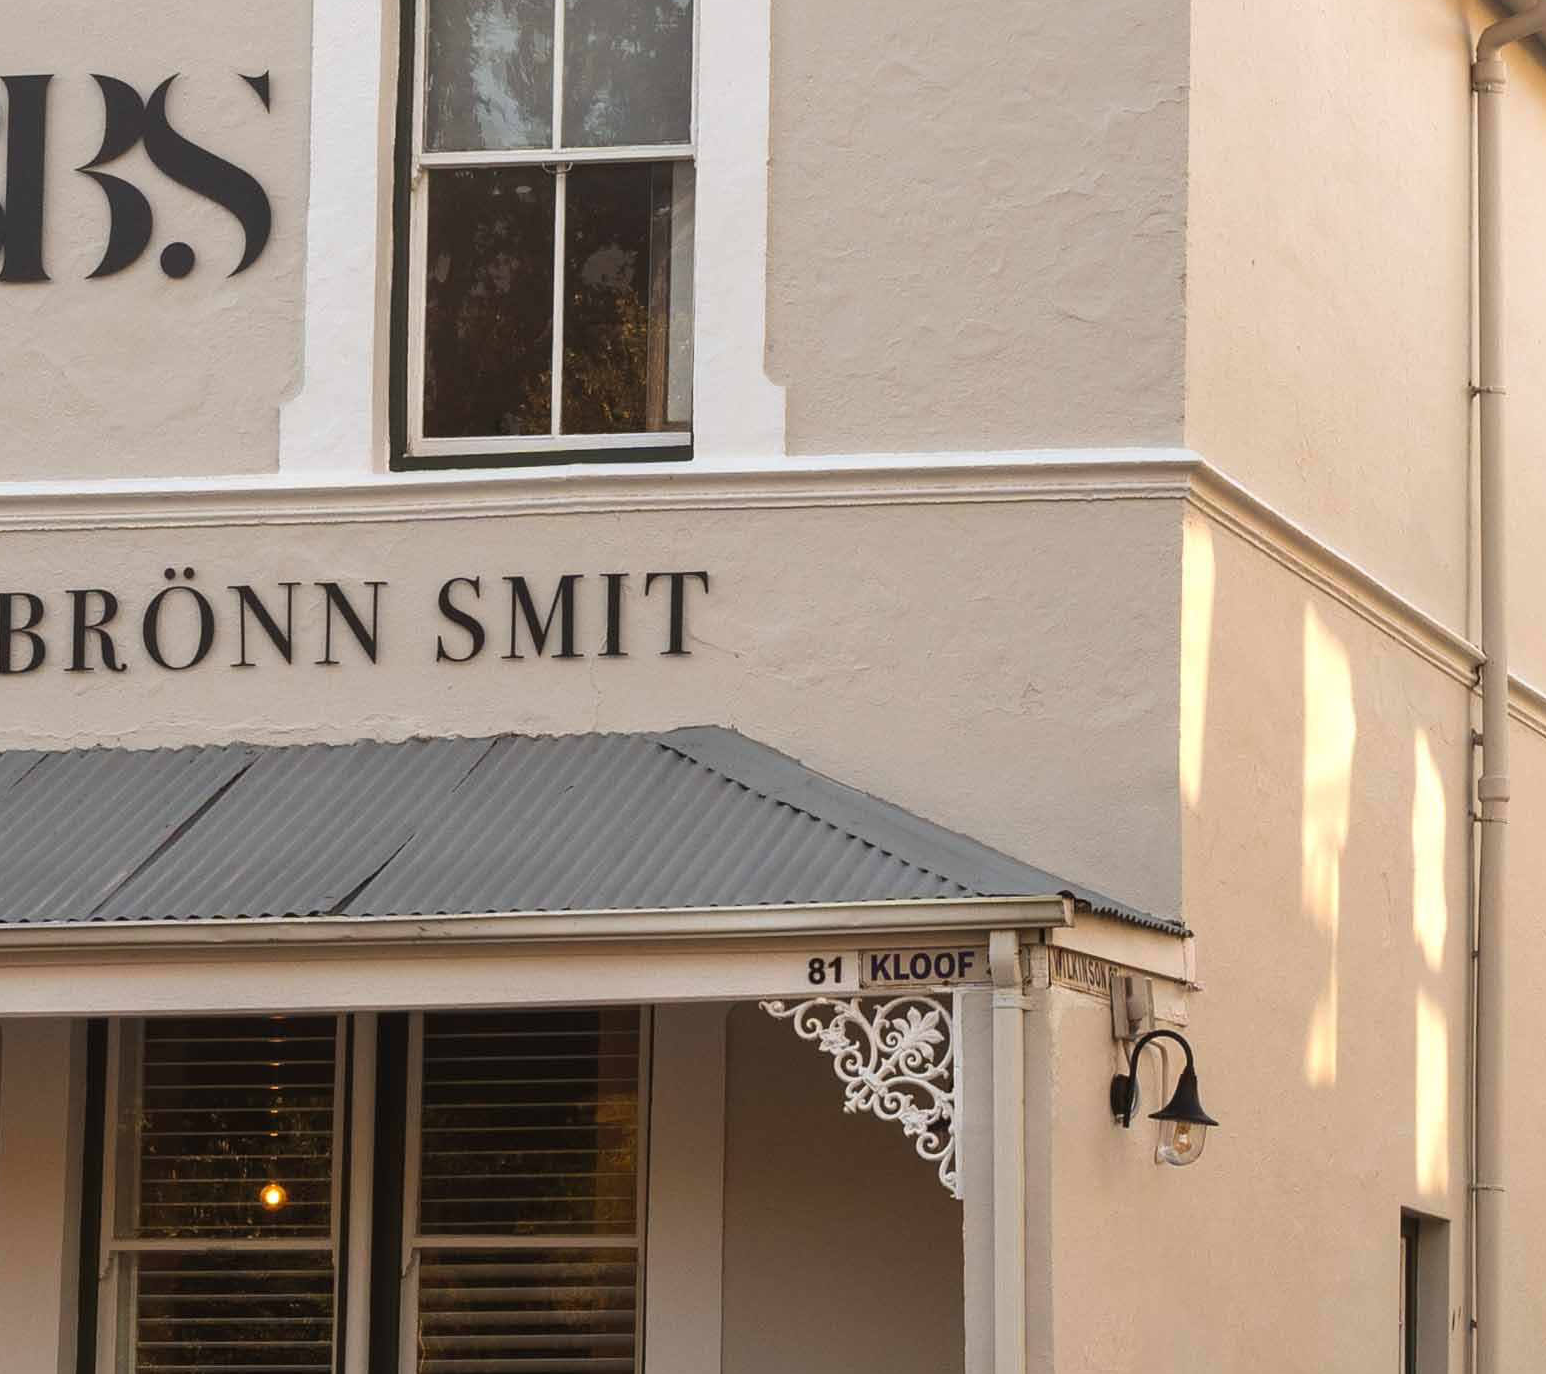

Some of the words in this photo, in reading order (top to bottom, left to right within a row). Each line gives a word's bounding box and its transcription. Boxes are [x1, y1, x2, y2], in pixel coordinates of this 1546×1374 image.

[436, 571, 710, 663] SMIT
[808, 956, 843, 985] 81
[870, 951, 975, 981] KLOOF
